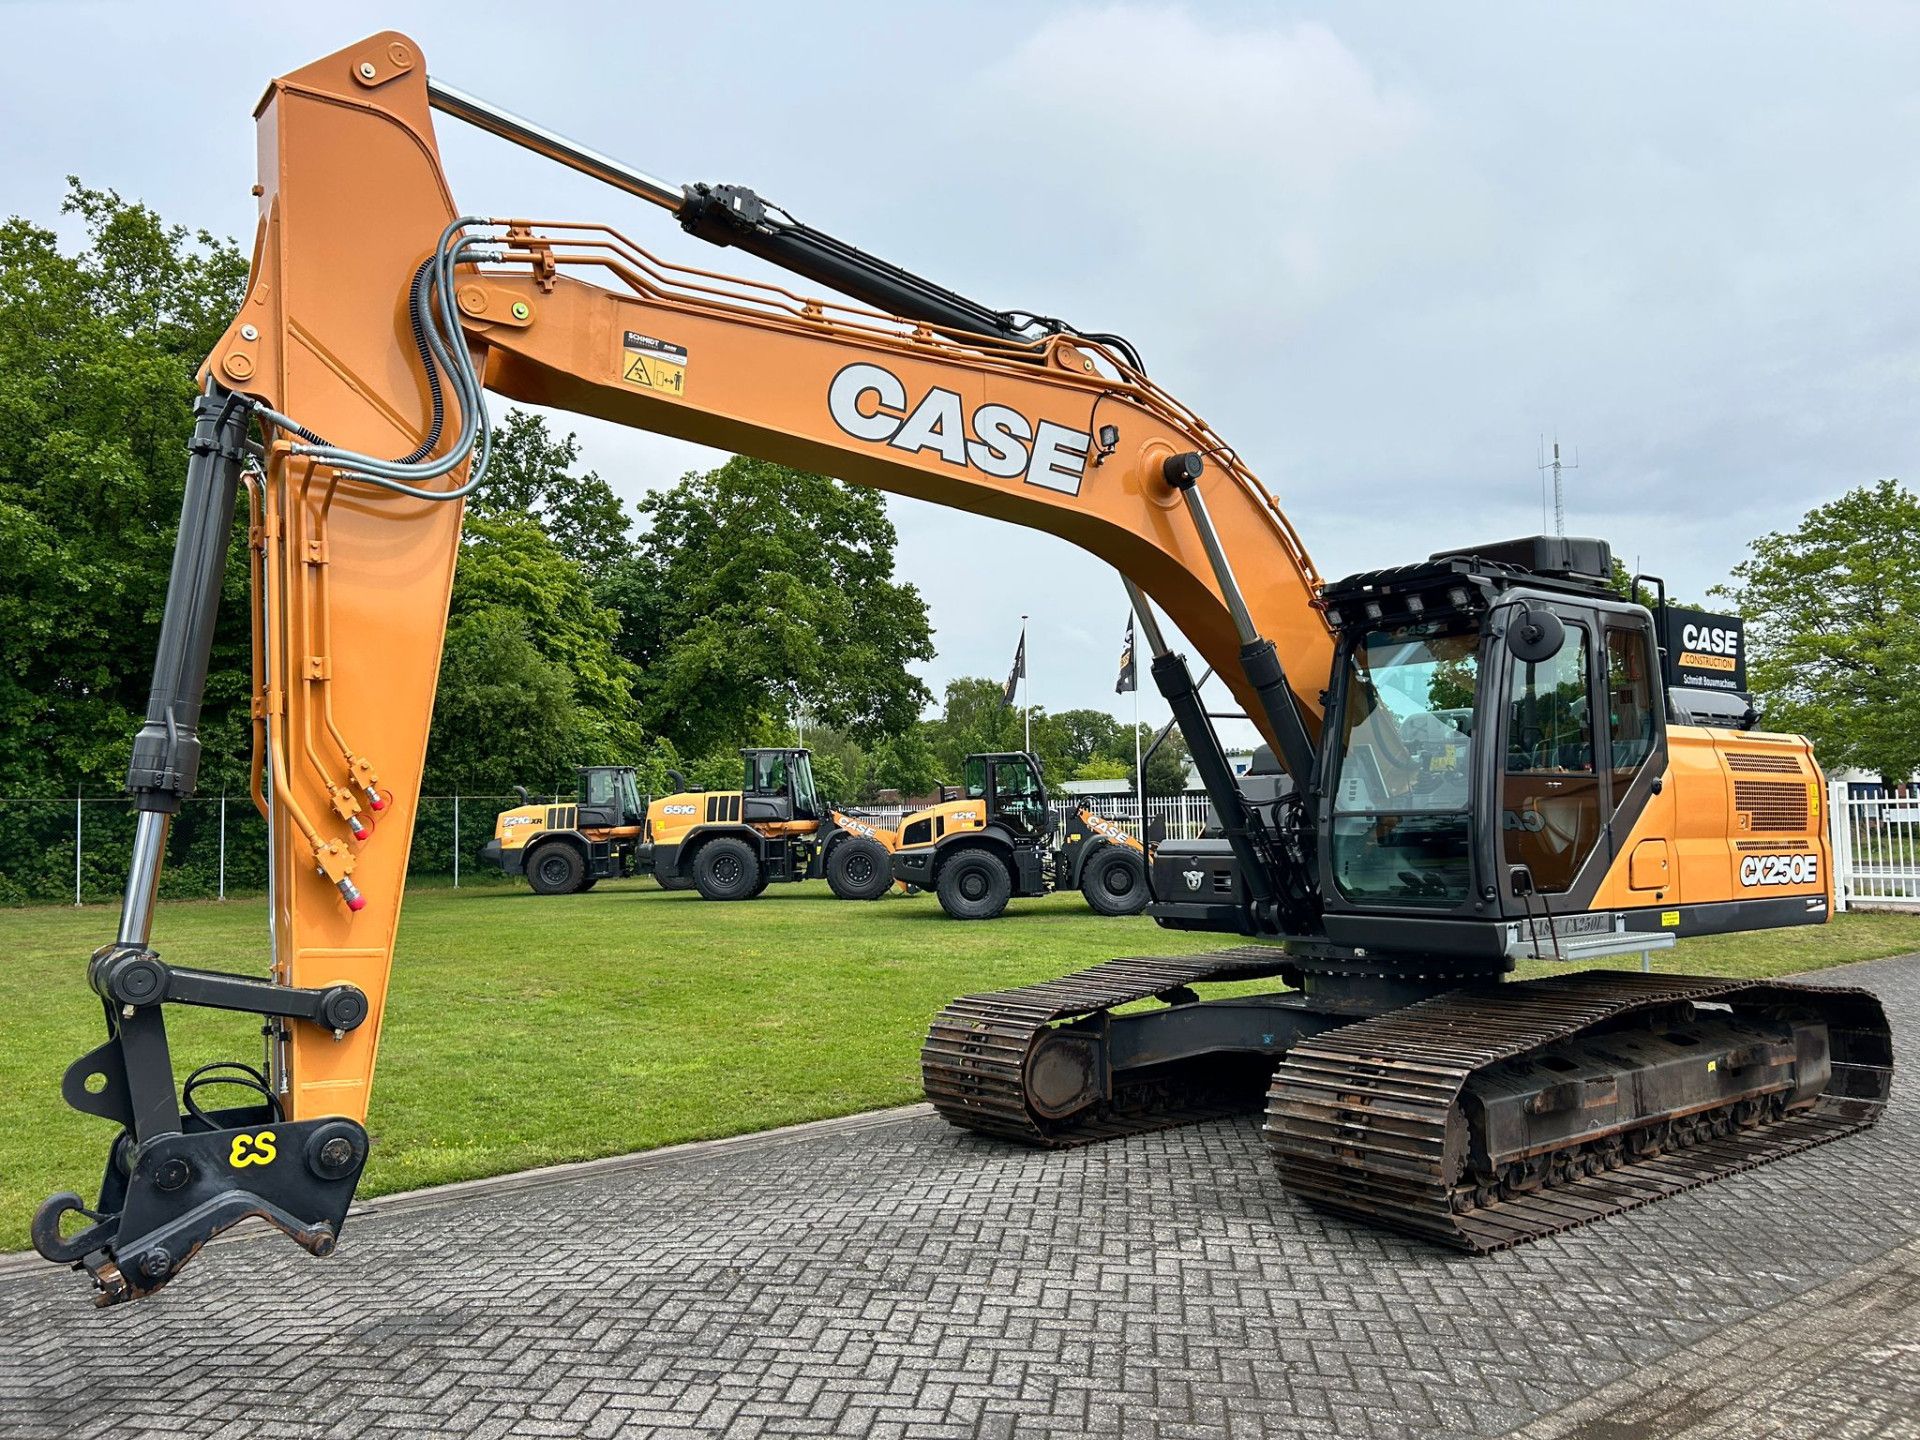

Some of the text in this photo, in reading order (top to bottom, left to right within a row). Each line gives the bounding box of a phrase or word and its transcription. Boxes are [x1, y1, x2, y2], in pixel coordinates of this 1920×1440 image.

[828, 361, 1092, 497] CASE
[1682, 623, 1738, 655] CASE
[1684, 654, 1733, 669] CONSTRUCTION
[663, 804, 697, 816] 651G
[839, 816, 877, 838] CASE
[1087, 815, 1129, 843] CASE
[1739, 853, 1817, 887] CX250E
